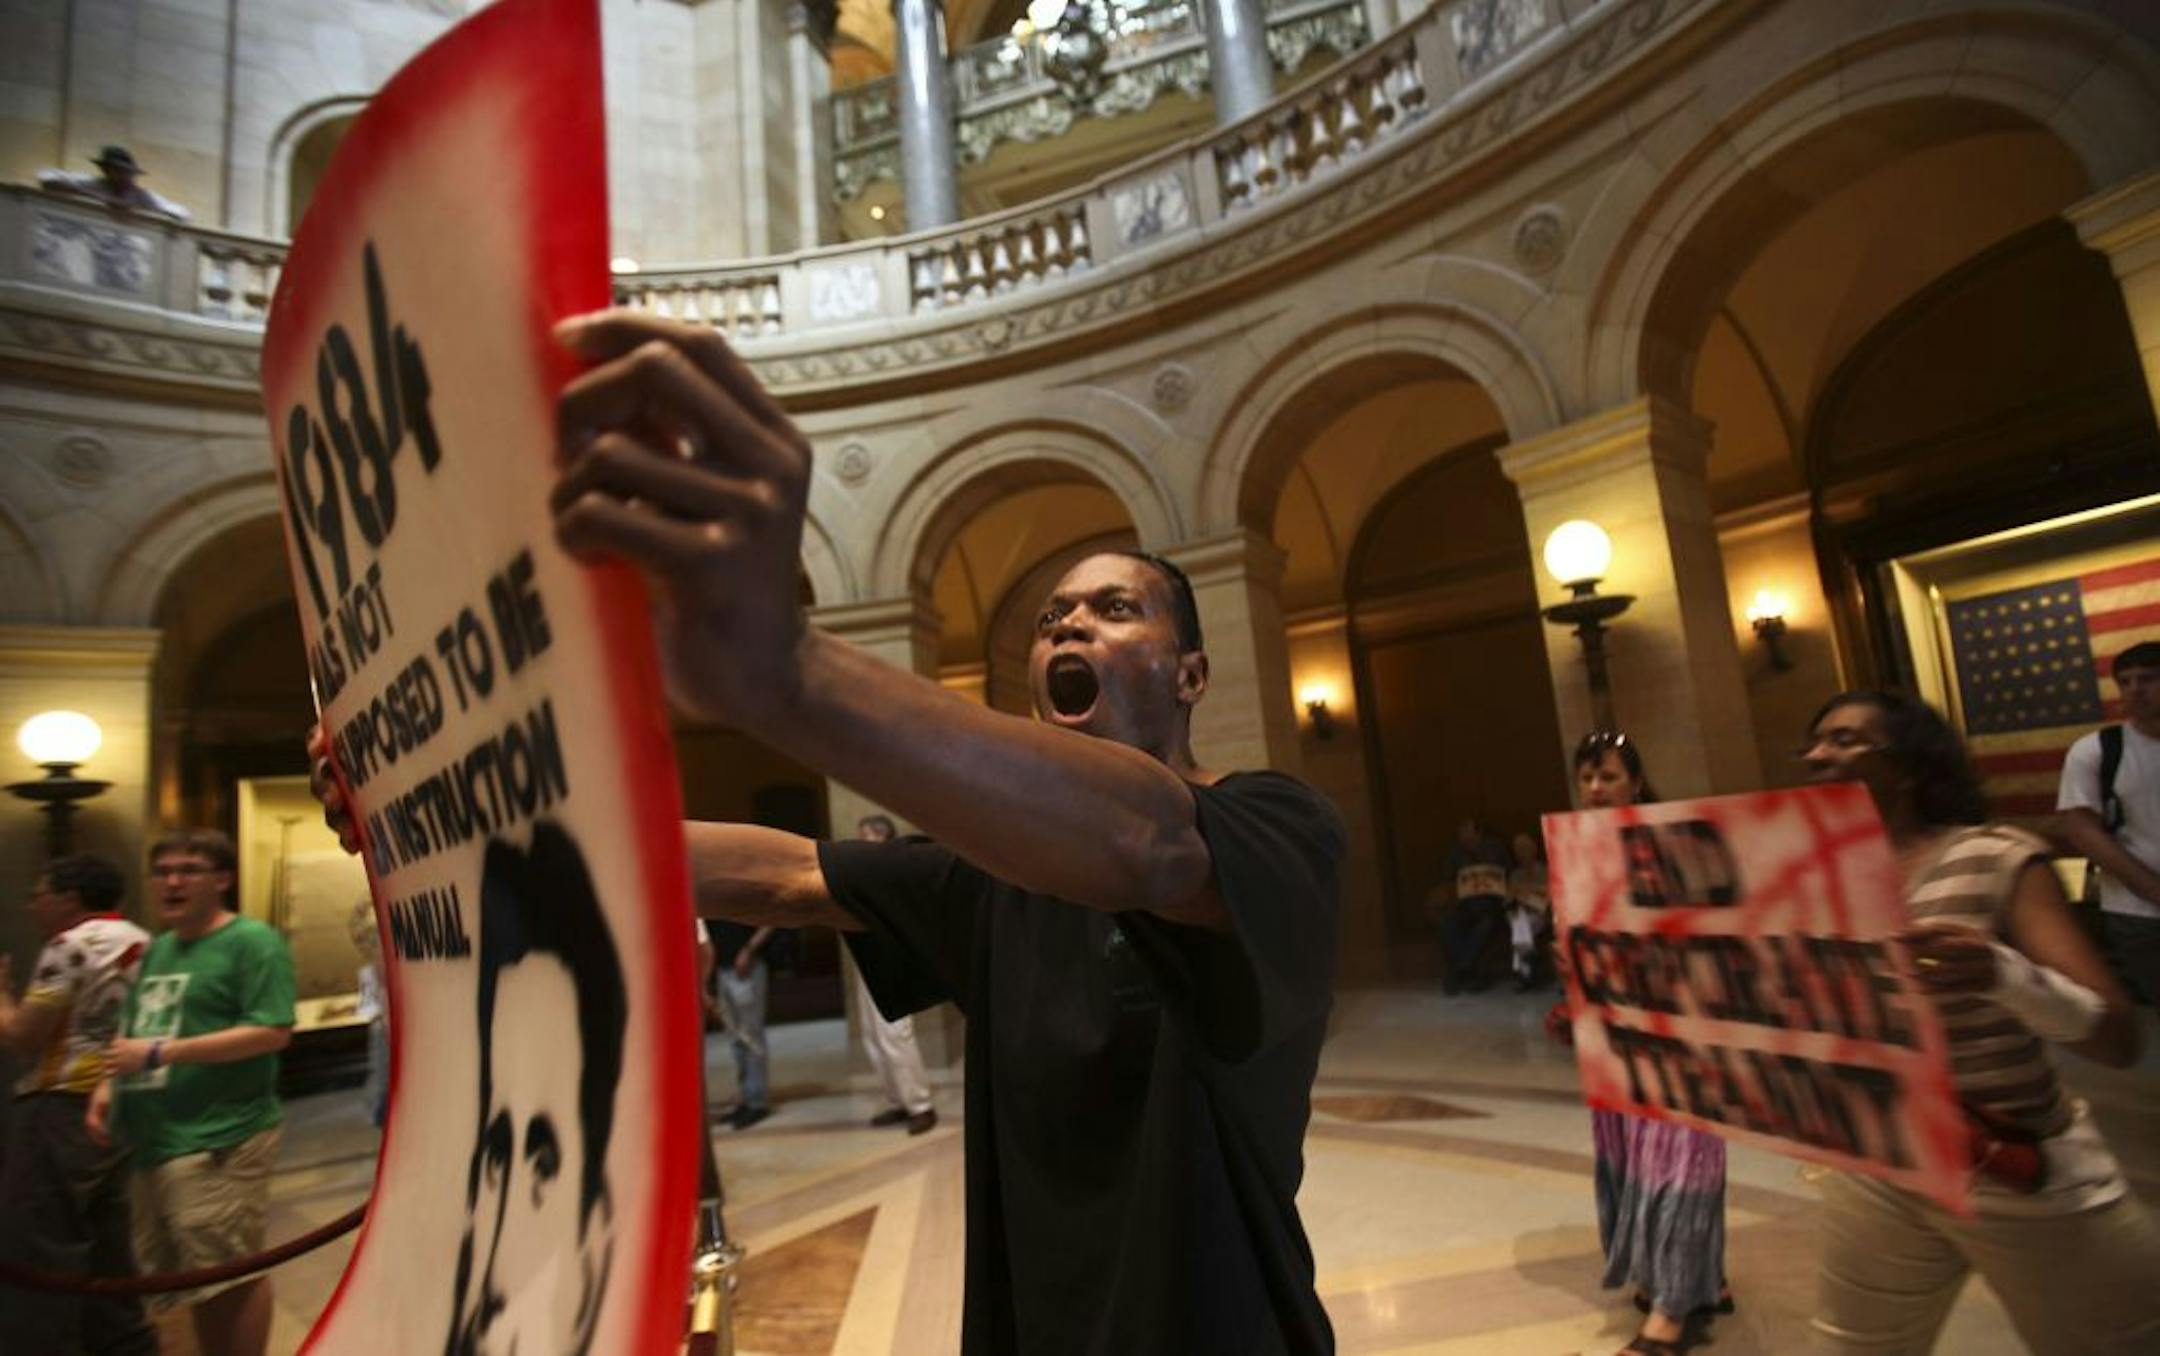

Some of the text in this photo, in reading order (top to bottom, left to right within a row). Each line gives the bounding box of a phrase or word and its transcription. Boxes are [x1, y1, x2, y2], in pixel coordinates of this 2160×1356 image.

[281, 238, 442, 623] 1984
[336, 562, 395, 675] NOT
[436, 606, 495, 712] TO
[486, 546, 554, 676] BE
[384, 696, 569, 868] INSTRUCTION
[388, 880, 471, 962] MANUAL
